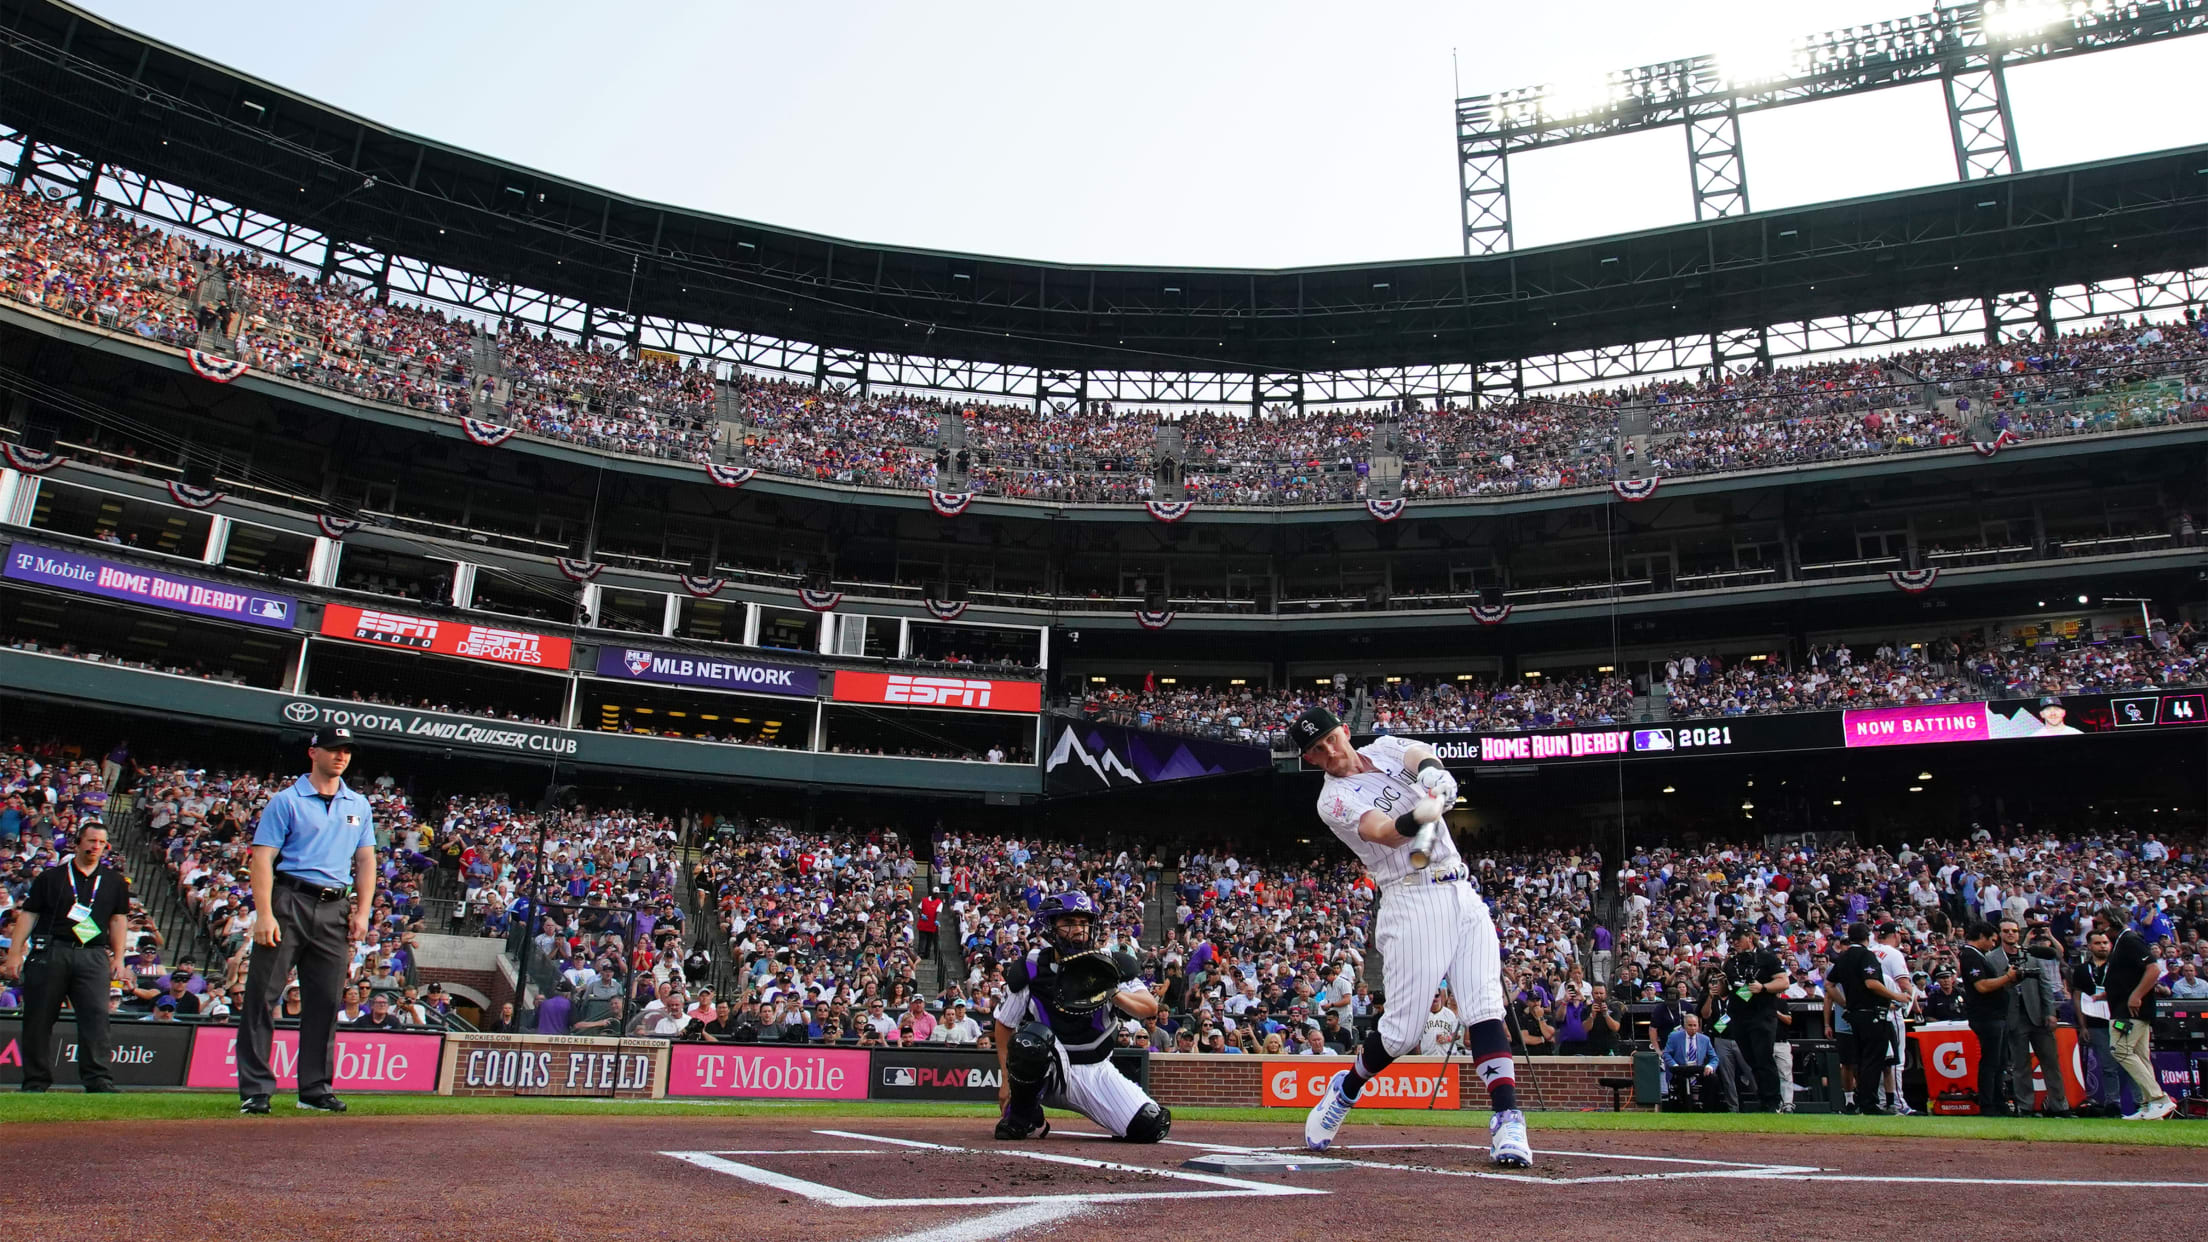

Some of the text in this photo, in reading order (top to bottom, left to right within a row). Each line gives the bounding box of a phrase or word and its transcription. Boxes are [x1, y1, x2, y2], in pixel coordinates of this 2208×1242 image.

[34, 557, 95, 581] Mobile
[98, 566, 149, 594] HOME
[151, 578, 189, 601] RUN
[190, 586, 247, 613] DERBY
[357, 610, 439, 639] ESPN
[356, 630, 432, 648] RADIO
[456, 641, 542, 663] DEPORTES
[468, 627, 540, 651] ESPN
[652, 658, 792, 686] MLB NETWORK
[885, 675, 992, 707] ESPN
[2174, 701, 2193, 718] 44
[322, 708, 403, 732] TOYOTA
[529, 735, 577, 753] CLUB
[1857, 716, 1976, 735] NOW BATTING
[1436, 726, 1732, 761] obile HOME RUN DERBY 2021
[464, 1034, 512, 1042] ROCKIES.COM
[623, 1039, 667, 1047] ROCKIES.COM
[467, 1050, 650, 1089] COORS FIELD
[730, 1055, 844, 1091] Mobile
[1308, 1076, 1448, 1098] GORADE
